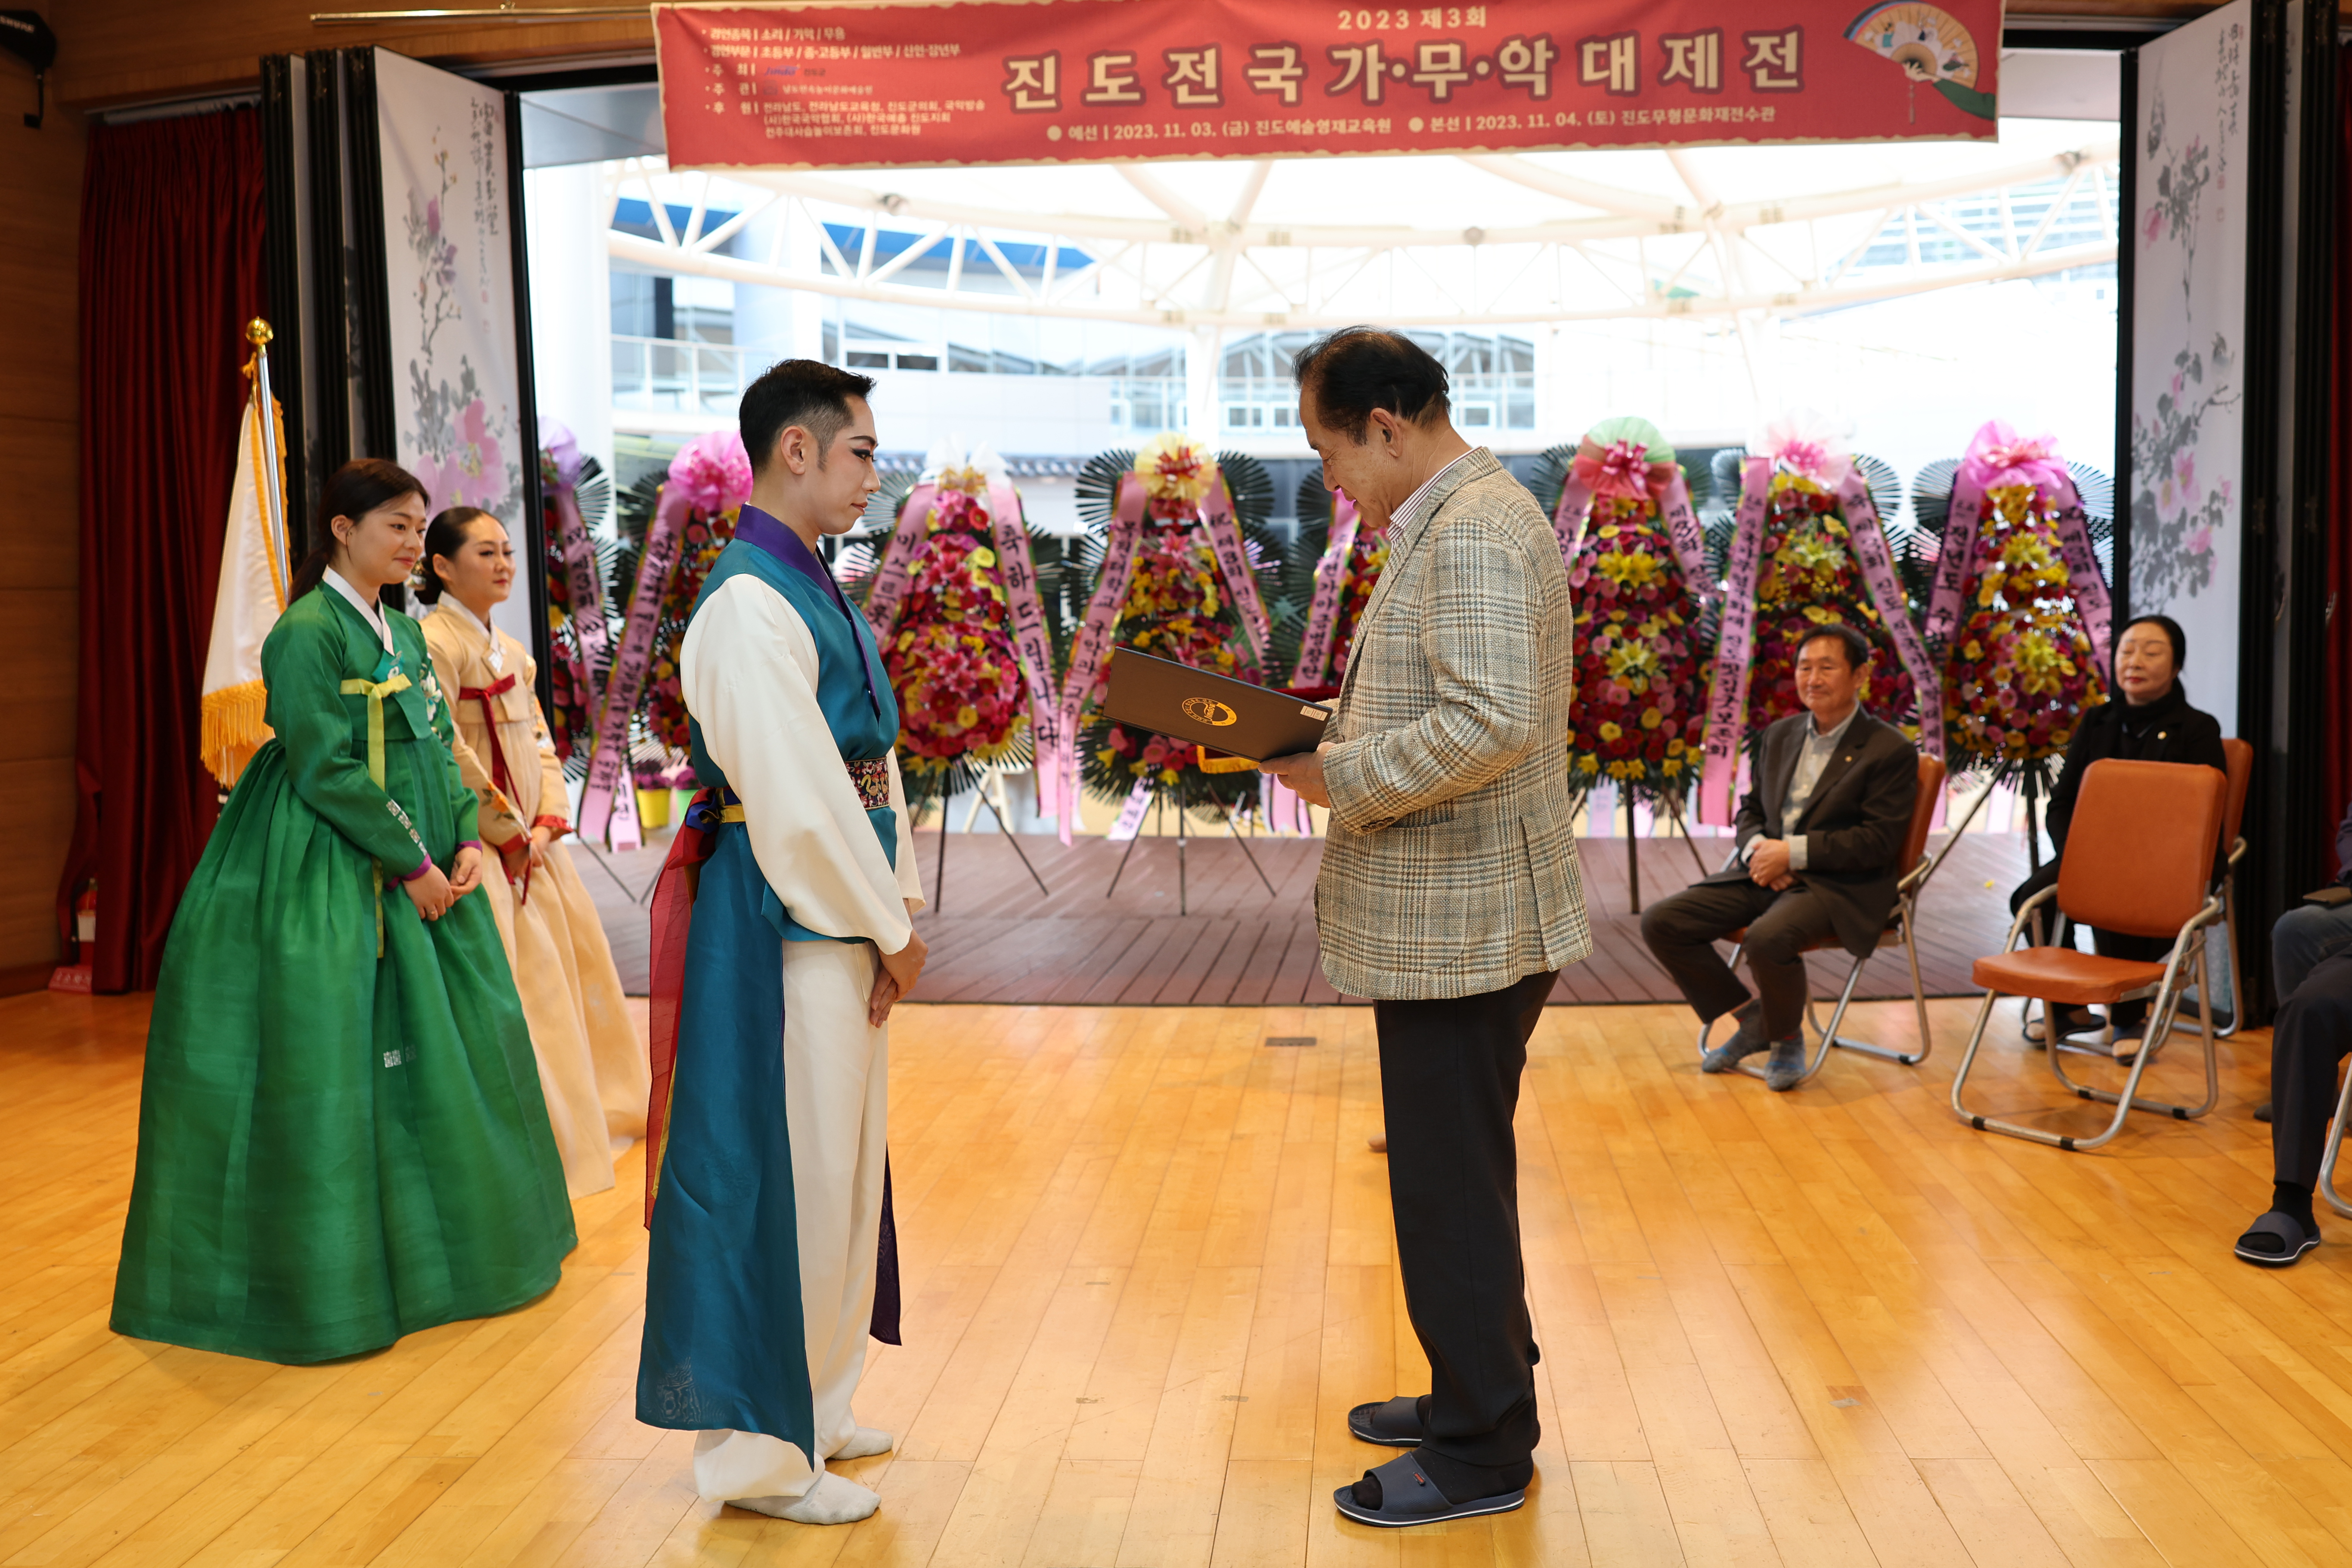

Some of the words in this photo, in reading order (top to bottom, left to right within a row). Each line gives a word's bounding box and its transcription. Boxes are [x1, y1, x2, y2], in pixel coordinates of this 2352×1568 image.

[1337, 9, 1410, 30] 2023
[1419, 6, 1486, 30] 제3회
[761, 28, 783, 41] 소리
[761, 46, 794, 59] 초등부
[1068, 125, 1098, 141] 예선
[1114, 124, 1158, 139] 2023.
[1164, 123, 1186, 138] 11.
[1190, 122, 1216, 137] 03.
[1222, 121, 1250, 137] (금)
[1430, 117, 1460, 133] 본선
[1476, 114, 1523, 130] 2023.
[1528, 113, 1550, 128] 11.
[1555, 112, 1581, 127] 04.
[1587, 110, 1615, 126] (토)
